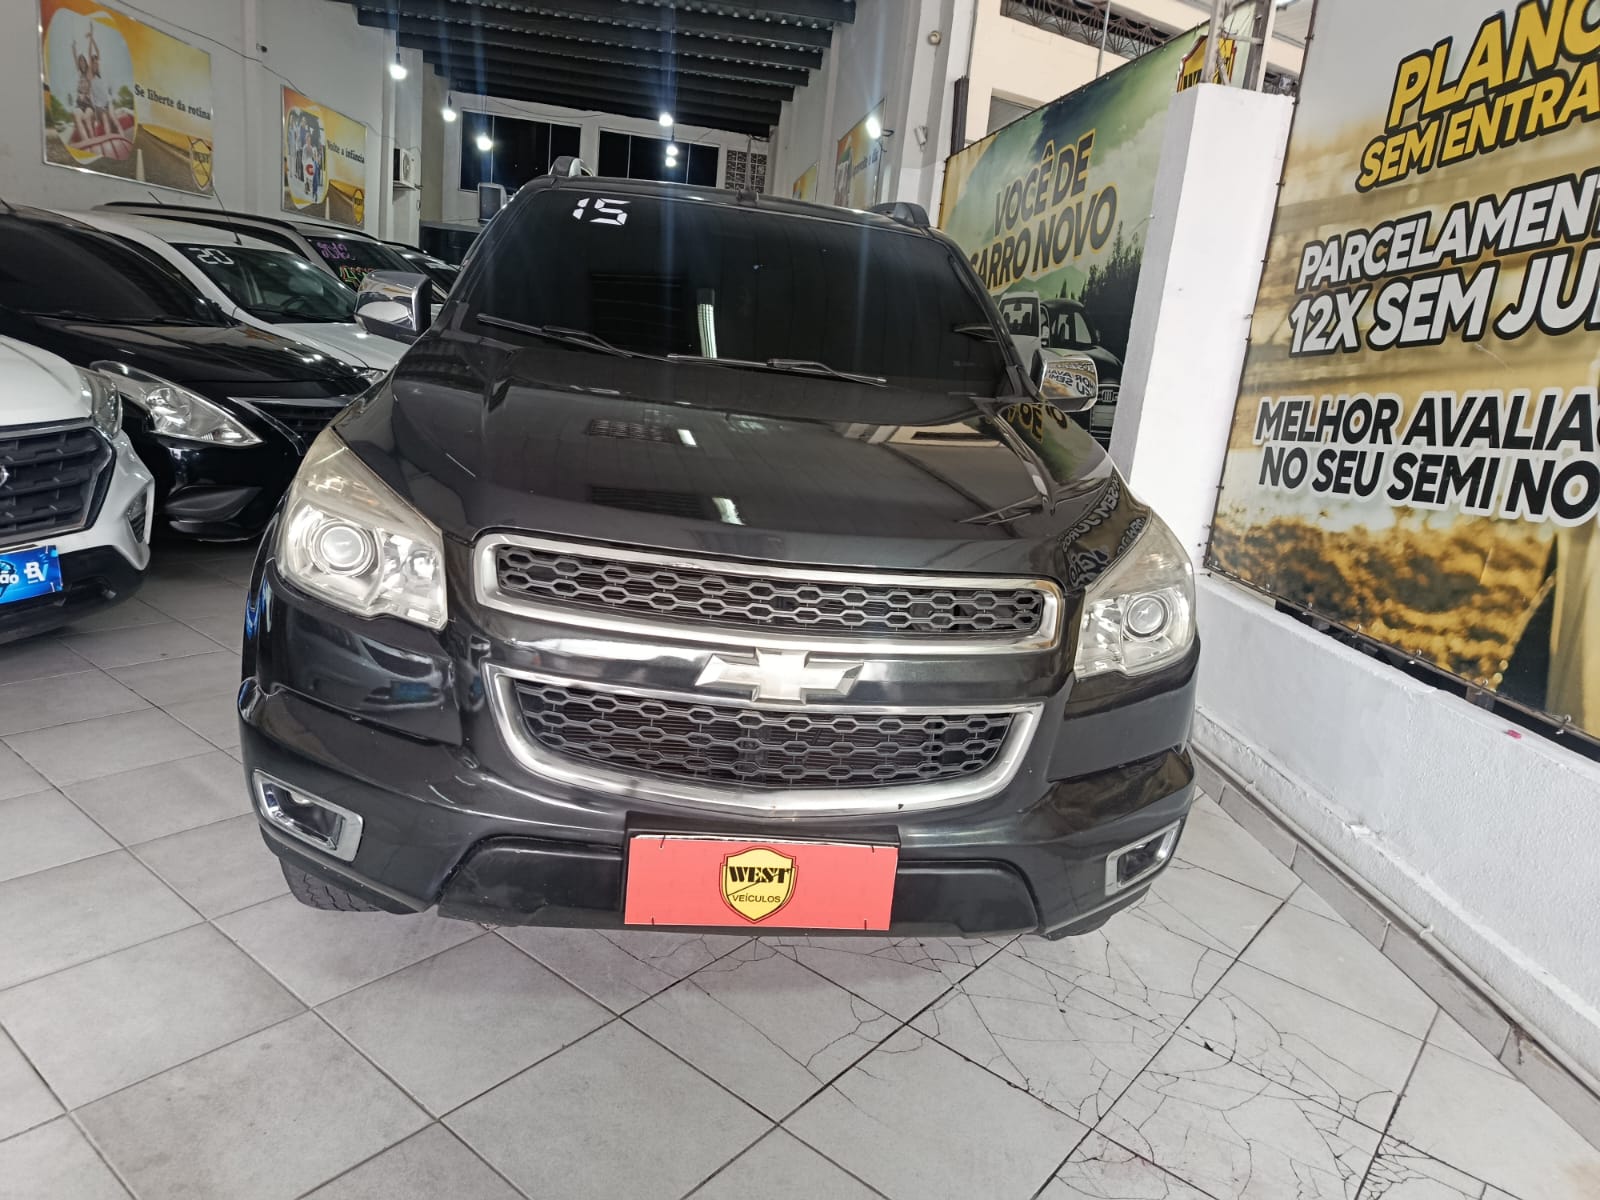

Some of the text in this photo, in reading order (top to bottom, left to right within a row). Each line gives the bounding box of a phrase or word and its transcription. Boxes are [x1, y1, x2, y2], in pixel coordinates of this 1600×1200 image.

[134, 84, 211, 121] Se liberte da rotina
[994, 132, 1095, 237] VOCÊ DE
[1357, 119, 1442, 189] SEM
[573, 196, 632, 226] 15
[1031, 184, 1118, 274] NOVO
[1296, 172, 1600, 291] PARCELAMEN
[188, 247, 235, 265] 20
[1290, 248, 1600, 354] 12X SEM JU
[1254, 393, 1600, 452] MELHOR AVALIA
[1257, 445, 1309, 489] NO
[1311, 447, 1385, 498] SEU
[1386, 451, 1501, 510] SEMI
[728, 865, 791, 884] WEST
[732, 892, 782, 904] VEÍCULOS
